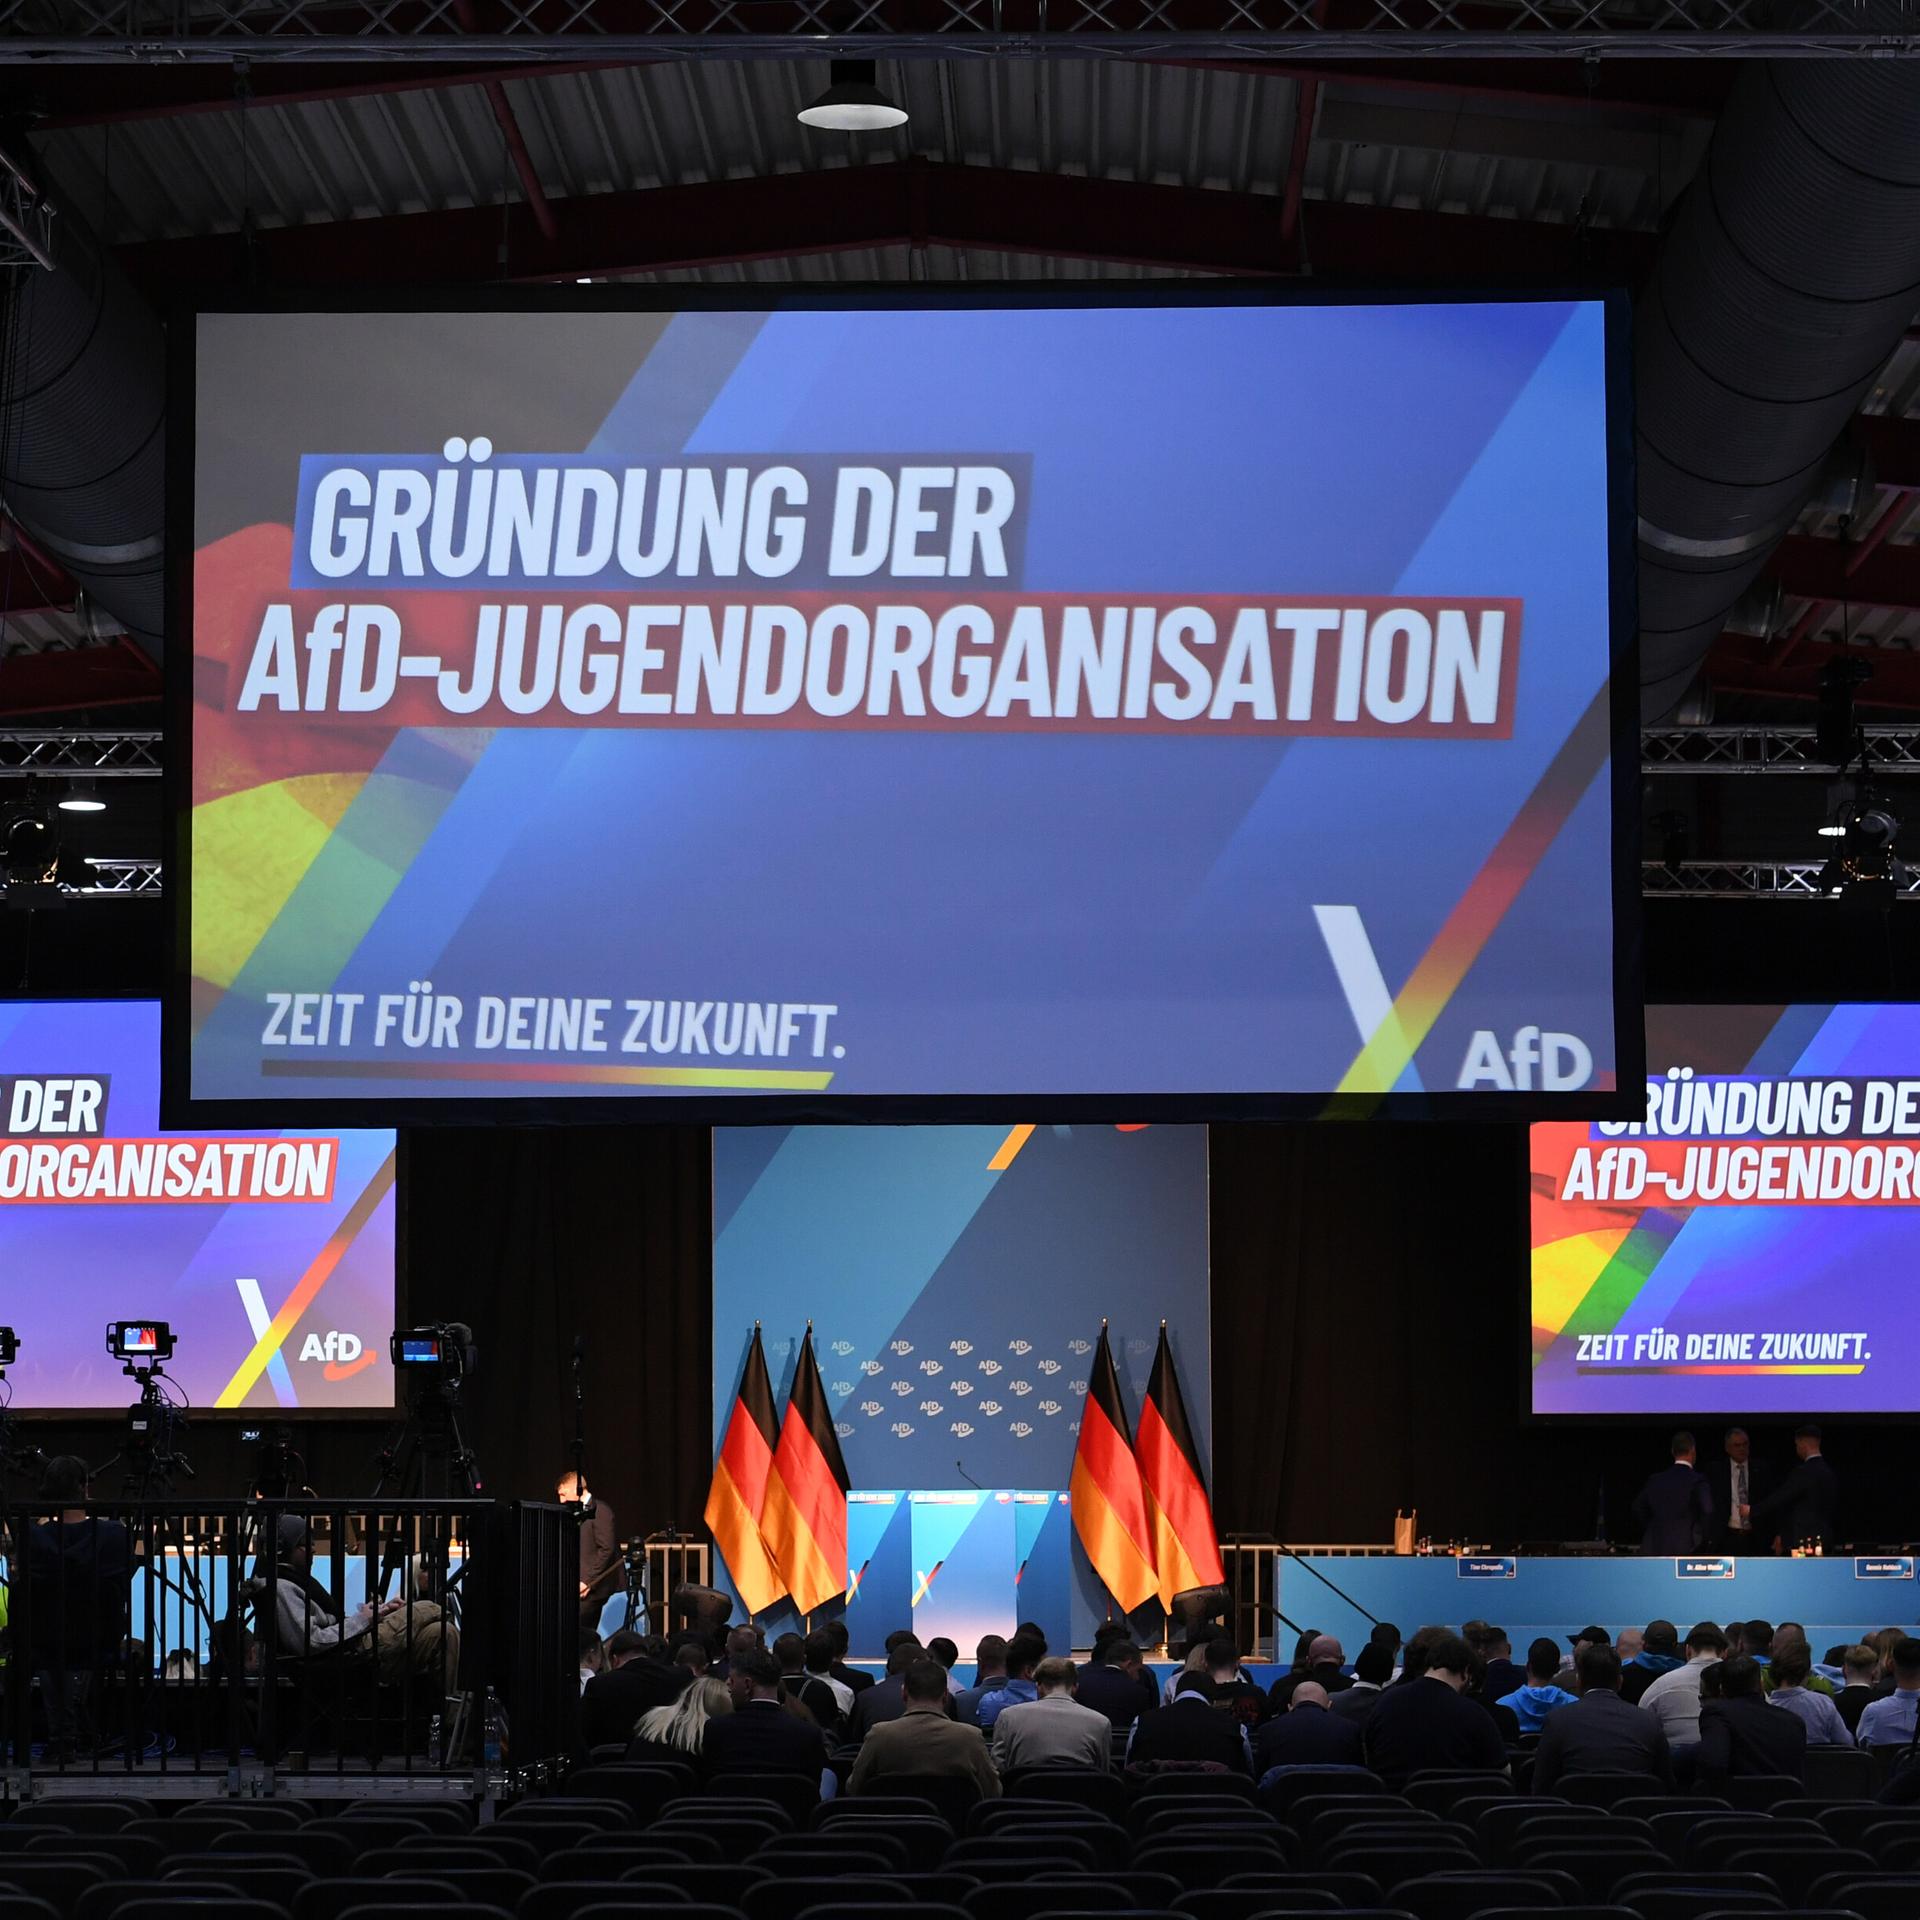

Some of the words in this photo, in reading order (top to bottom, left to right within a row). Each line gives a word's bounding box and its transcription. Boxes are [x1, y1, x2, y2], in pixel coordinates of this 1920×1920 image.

[310, 437, 808, 578] GRÜNDUNG
[828, 466, 1015, 577] DER
[237, 604, 1505, 723] AfD-JUGENDORGANISATION
[262, 993, 364, 1046] ZEIT
[374, 980, 463, 1048] FÜR
[474, 996, 611, 1052] DEINE
[621, 999, 846, 1059] ZUKUNFT.
[1457, 1025, 1593, 1091] AfD
[8, 1079, 103, 1132] DER
[1598, 1067, 1853, 1135] RÜNDUNG
[1561, 1146, 1920, 1200] AfD-JUGENDOR
[299, 1332, 362, 1361] AfD
[831, 1341, 850, 1351] AfD
[890, 1341, 909, 1351] AfD
[950, 1340, 969, 1350] AfD
[1009, 1340, 1028, 1350] AfD
[1576, 1334, 1629, 1360] ZEIT
[1634, 1327, 1680, 1360] FÜR
[1685, 1333, 1753, 1360] DEINE
[1759, 1332, 1871, 1360] ZUKUNFT.
[860, 1361, 879, 1371] AfD
[919, 1361, 939, 1371] AfD
[979, 1360, 998, 1370] AfD
[1038, 1360, 1057, 1370] AfD
[831, 1381, 850, 1391] AfD
[891, 1381, 910, 1391] AfD
[950, 1381, 969, 1391] AfD
[1009, 1381, 1028, 1391] AfD
[860, 1401, 880, 1411] AfD
[920, 1401, 939, 1411] AfD
[979, 1401, 998, 1411] AfD
[1038, 1401, 1058, 1411] AfD
[891, 1422, 910, 1432] AfD
[950, 1422, 970, 1432] AfD
[1009, 1422, 1028, 1432] AfD
